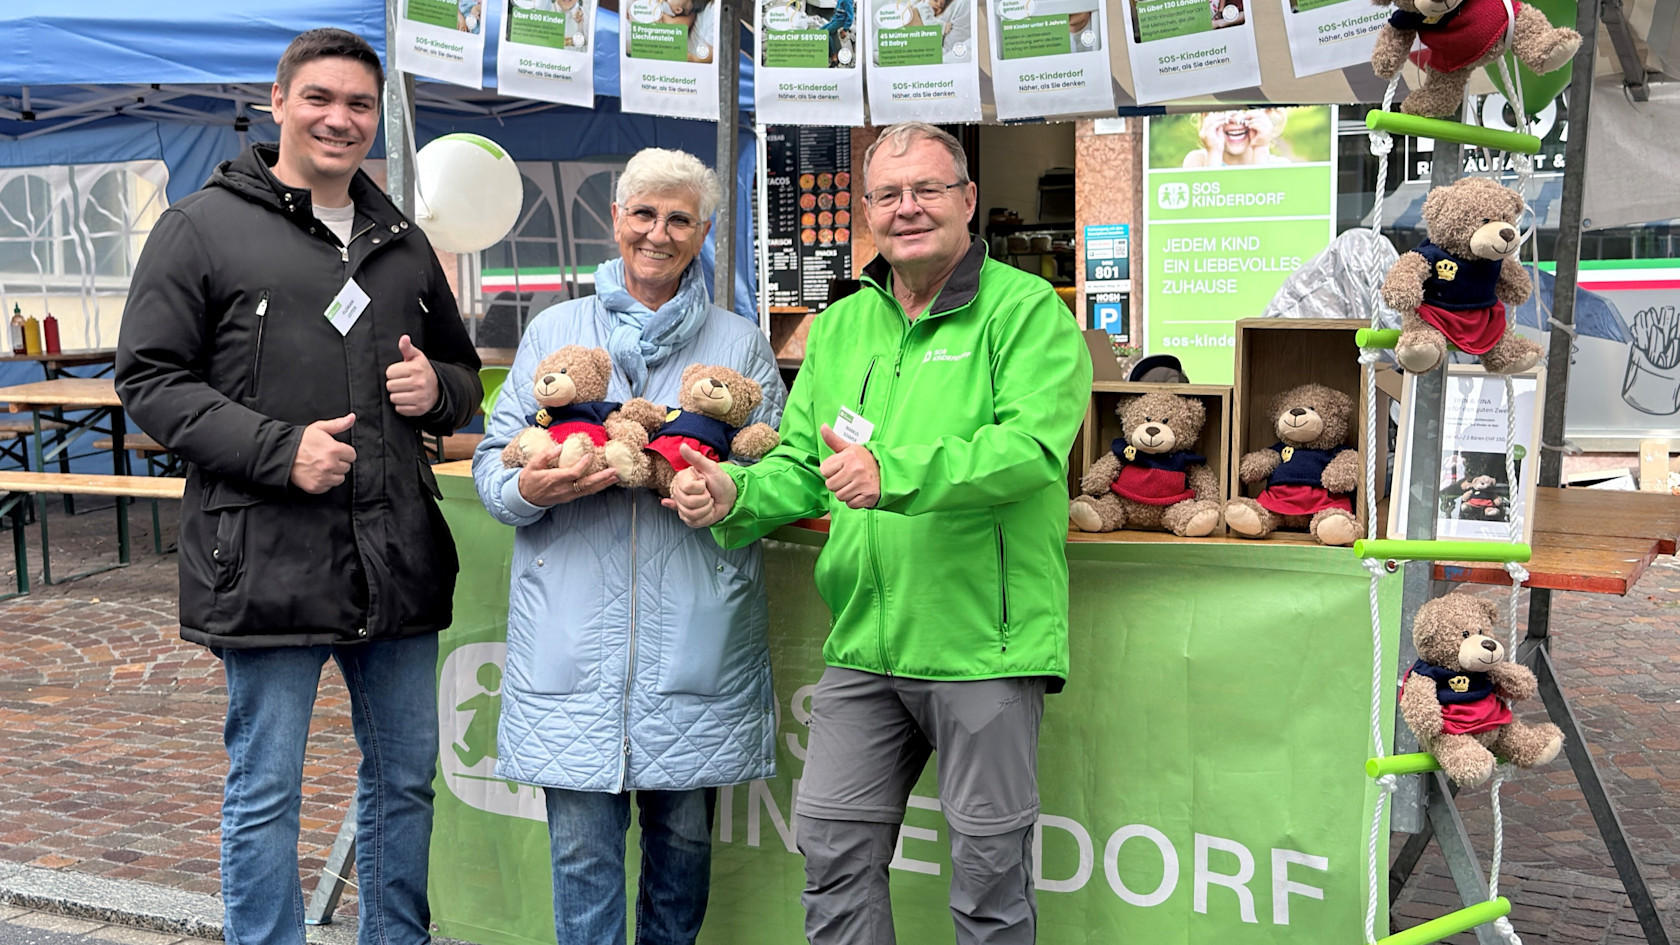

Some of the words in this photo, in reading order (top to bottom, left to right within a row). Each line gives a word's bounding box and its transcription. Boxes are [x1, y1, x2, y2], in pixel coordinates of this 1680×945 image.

[1147, 4, 1163, 12] über
[513, 10, 529, 19] Über
[530, 13, 542, 21] 600
[543, 14, 564, 24] Kinder
[1318, 9, 1392, 33] SOS-Kinderdorf
[633, 33, 674, 42] Liechtenstein
[638, 26, 674, 35] Programme
[1318, 34, 1342, 44] Näher,
[1344, 30, 1354, 38] als
[1368, 23, 1386, 32] denk
[1158, 45, 1227, 64] SOS-Kinderdorf
[519, 59, 571, 72] SOS-Kinderdorf
[1159, 66, 1181, 74] Näher,
[1182, 62, 1192, 70] als
[1193, 61, 1203, 69] Sie
[1205, 57, 1229, 66] denken
[642, 74, 696, 85] SOS-Kinderdorf
[1019, 68, 1083, 82] SOS-Kinderdorf
[892, 80, 954, 90] SOS-Kinderdorf
[1553, 154, 1565, 167] &
[1192, 182, 1220, 194] SOS
[1192, 192, 1286, 208] KINDERDORF
[1163, 237, 1216, 252] JEDEM
[1221, 236, 1260, 251] KIND
[1163, 258, 1189, 274] EIN
[1194, 256, 1301, 273] LIEBEVOLLES
[1095, 266, 1118, 279] 801
[1161, 279, 1238, 294] ZUHAUSE
[1100, 308, 1118, 329] P
[1162, 333, 1235, 348] sos-kinde
